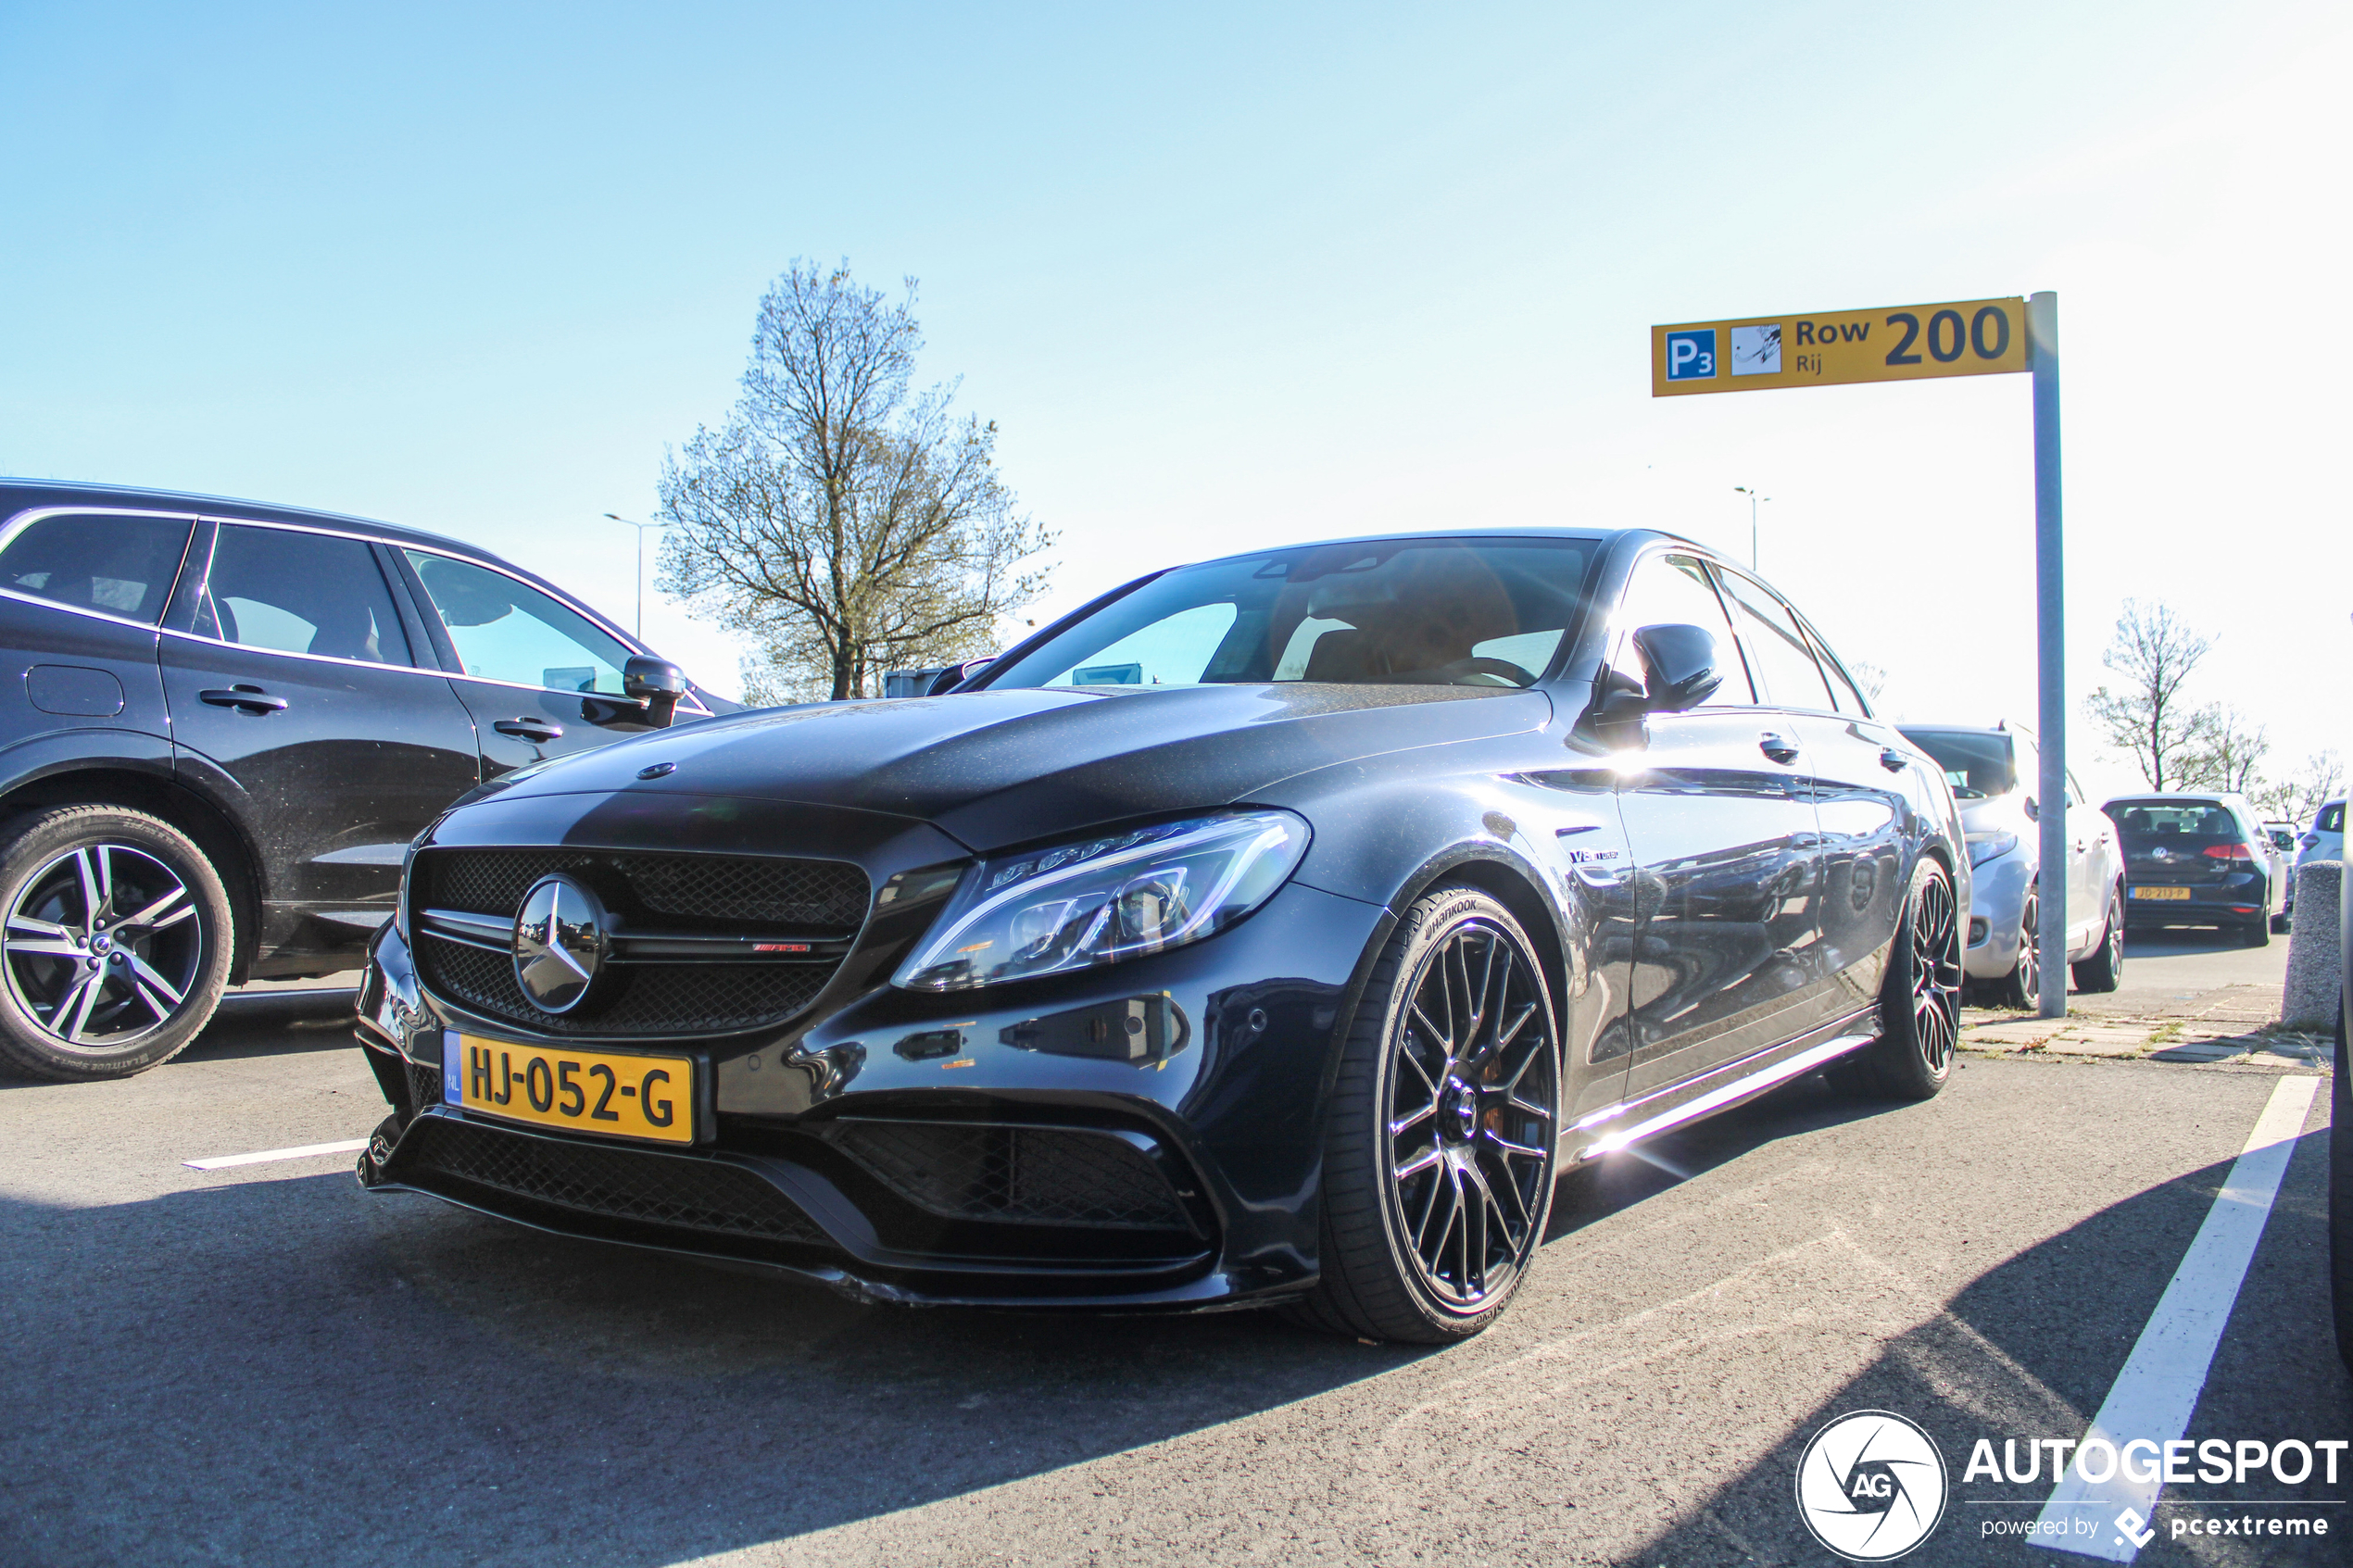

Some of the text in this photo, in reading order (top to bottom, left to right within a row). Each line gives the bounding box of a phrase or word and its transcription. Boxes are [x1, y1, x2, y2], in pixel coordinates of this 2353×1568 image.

[1796, 306, 2010, 366] Row 200
[1796, 353, 1822, 376] Rij
[447, 1073, 459, 1092] NL
[470, 1046, 673, 1128] HJ-052-G
